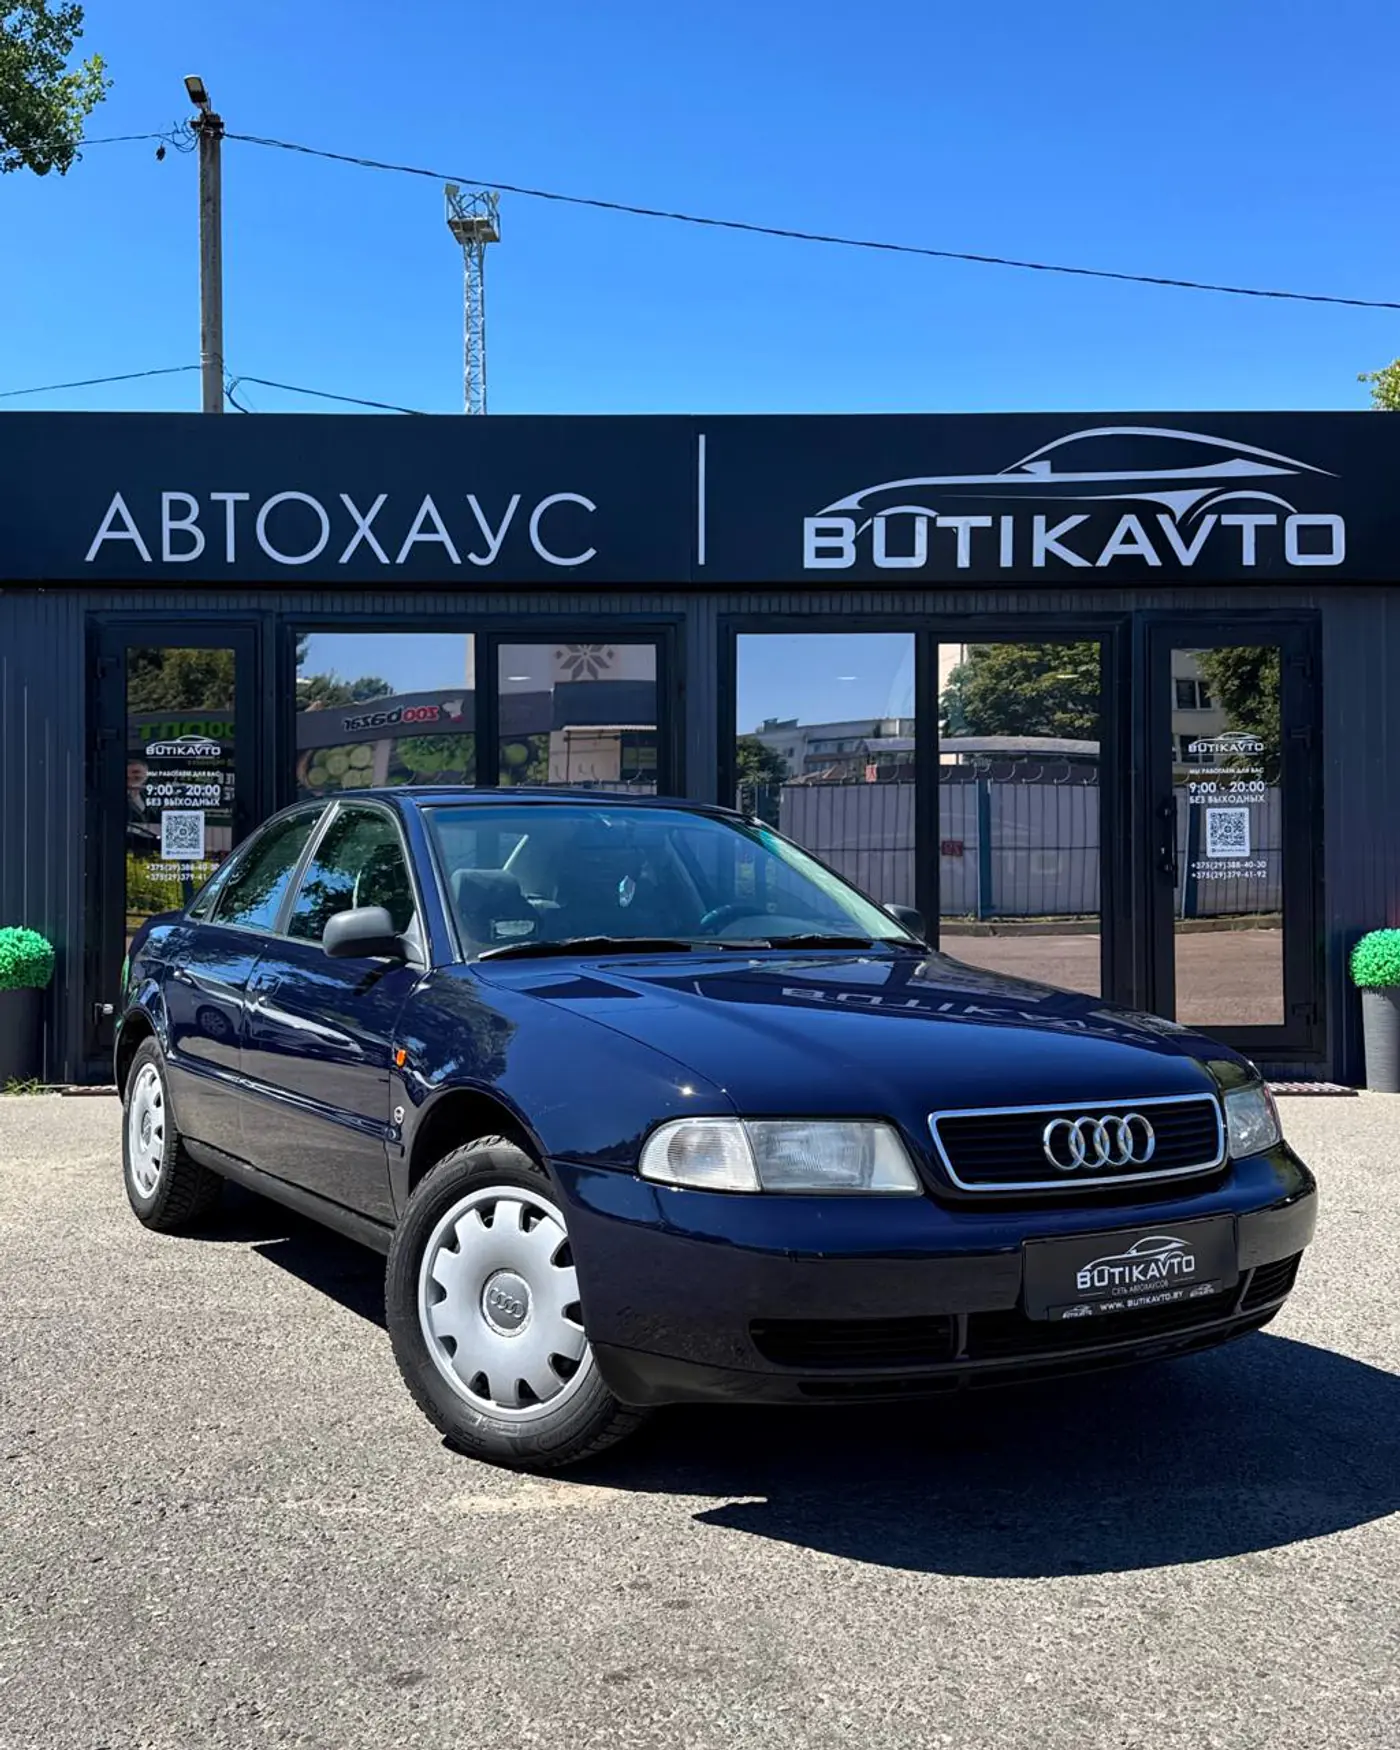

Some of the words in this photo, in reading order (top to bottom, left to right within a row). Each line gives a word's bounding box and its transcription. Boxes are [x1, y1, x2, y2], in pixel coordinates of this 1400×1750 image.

[86, 491, 597, 566] АВТОХАУС
[804, 513, 1345, 569] BUTIKAVTO
[146, 745, 221, 755] BUTIKAVTO
[1188, 743, 1264, 753] BUTIKAVTO
[146, 784, 173, 796] 9:00
[185, 784, 220, 796] 20:00
[1189, 782, 1217, 793] 9:00
[1229, 781, 1265, 792] 20:00
[146, 797, 161, 807] БЕЗ
[164, 797, 220, 807] ВЫХОДНЫХ
[1189, 795, 1205, 804] БЕЗ
[1208, 794, 1265, 804] ВЫХОДНЫХ
[1077, 1254, 1195, 1290] BUTIKAVTO
